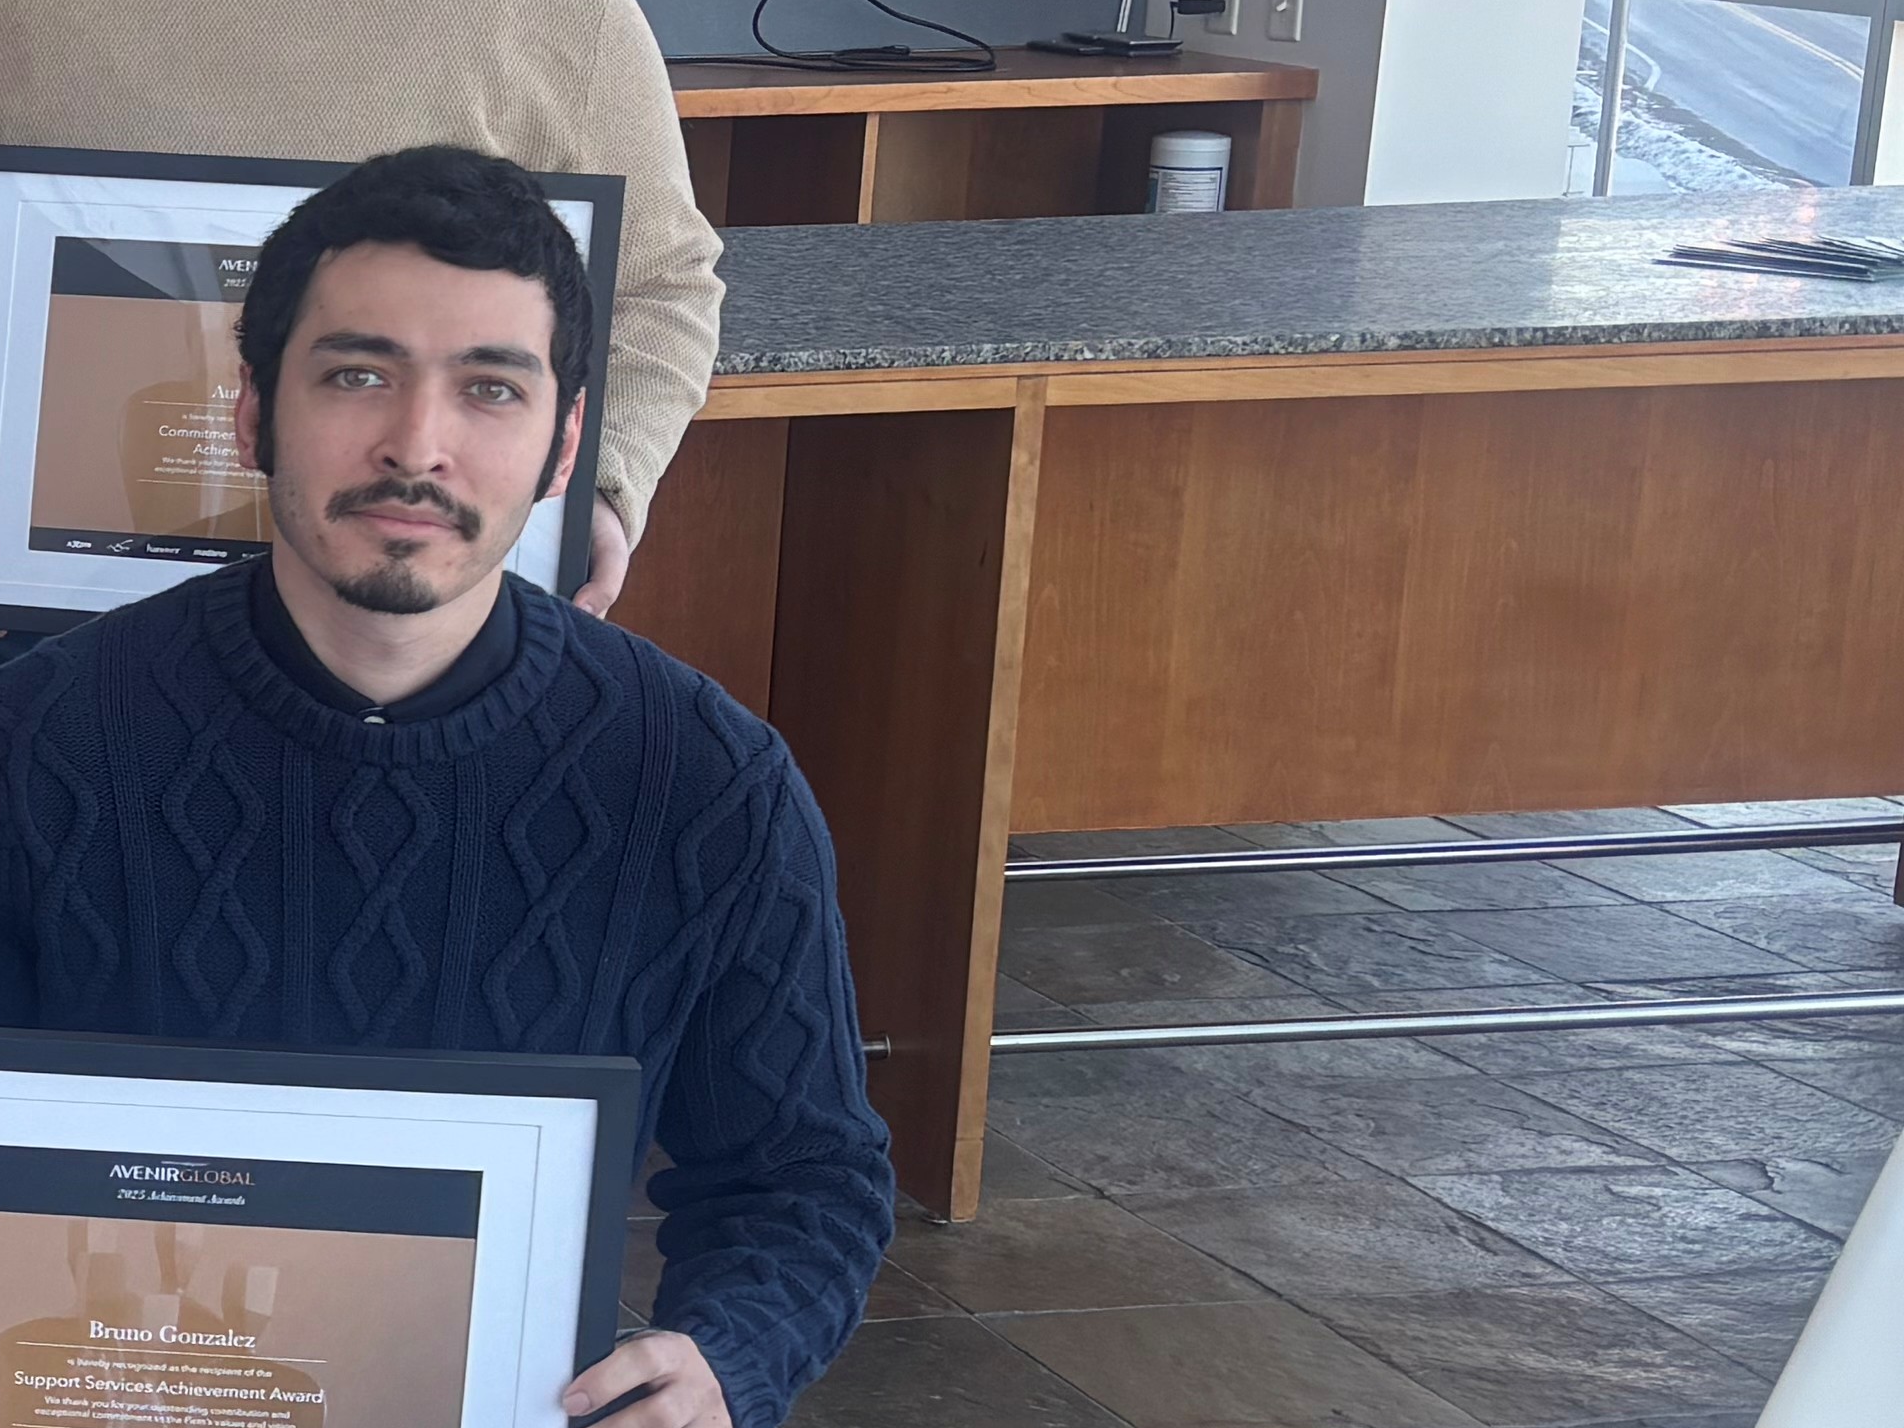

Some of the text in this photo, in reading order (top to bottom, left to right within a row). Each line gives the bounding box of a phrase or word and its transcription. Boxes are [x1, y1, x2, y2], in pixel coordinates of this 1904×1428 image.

[158, 425, 236, 440] Commitmen
[89, 1319, 256, 1348] Bruno Gonzalez
[14, 1370, 324, 1404] Support Services Achievement Award
